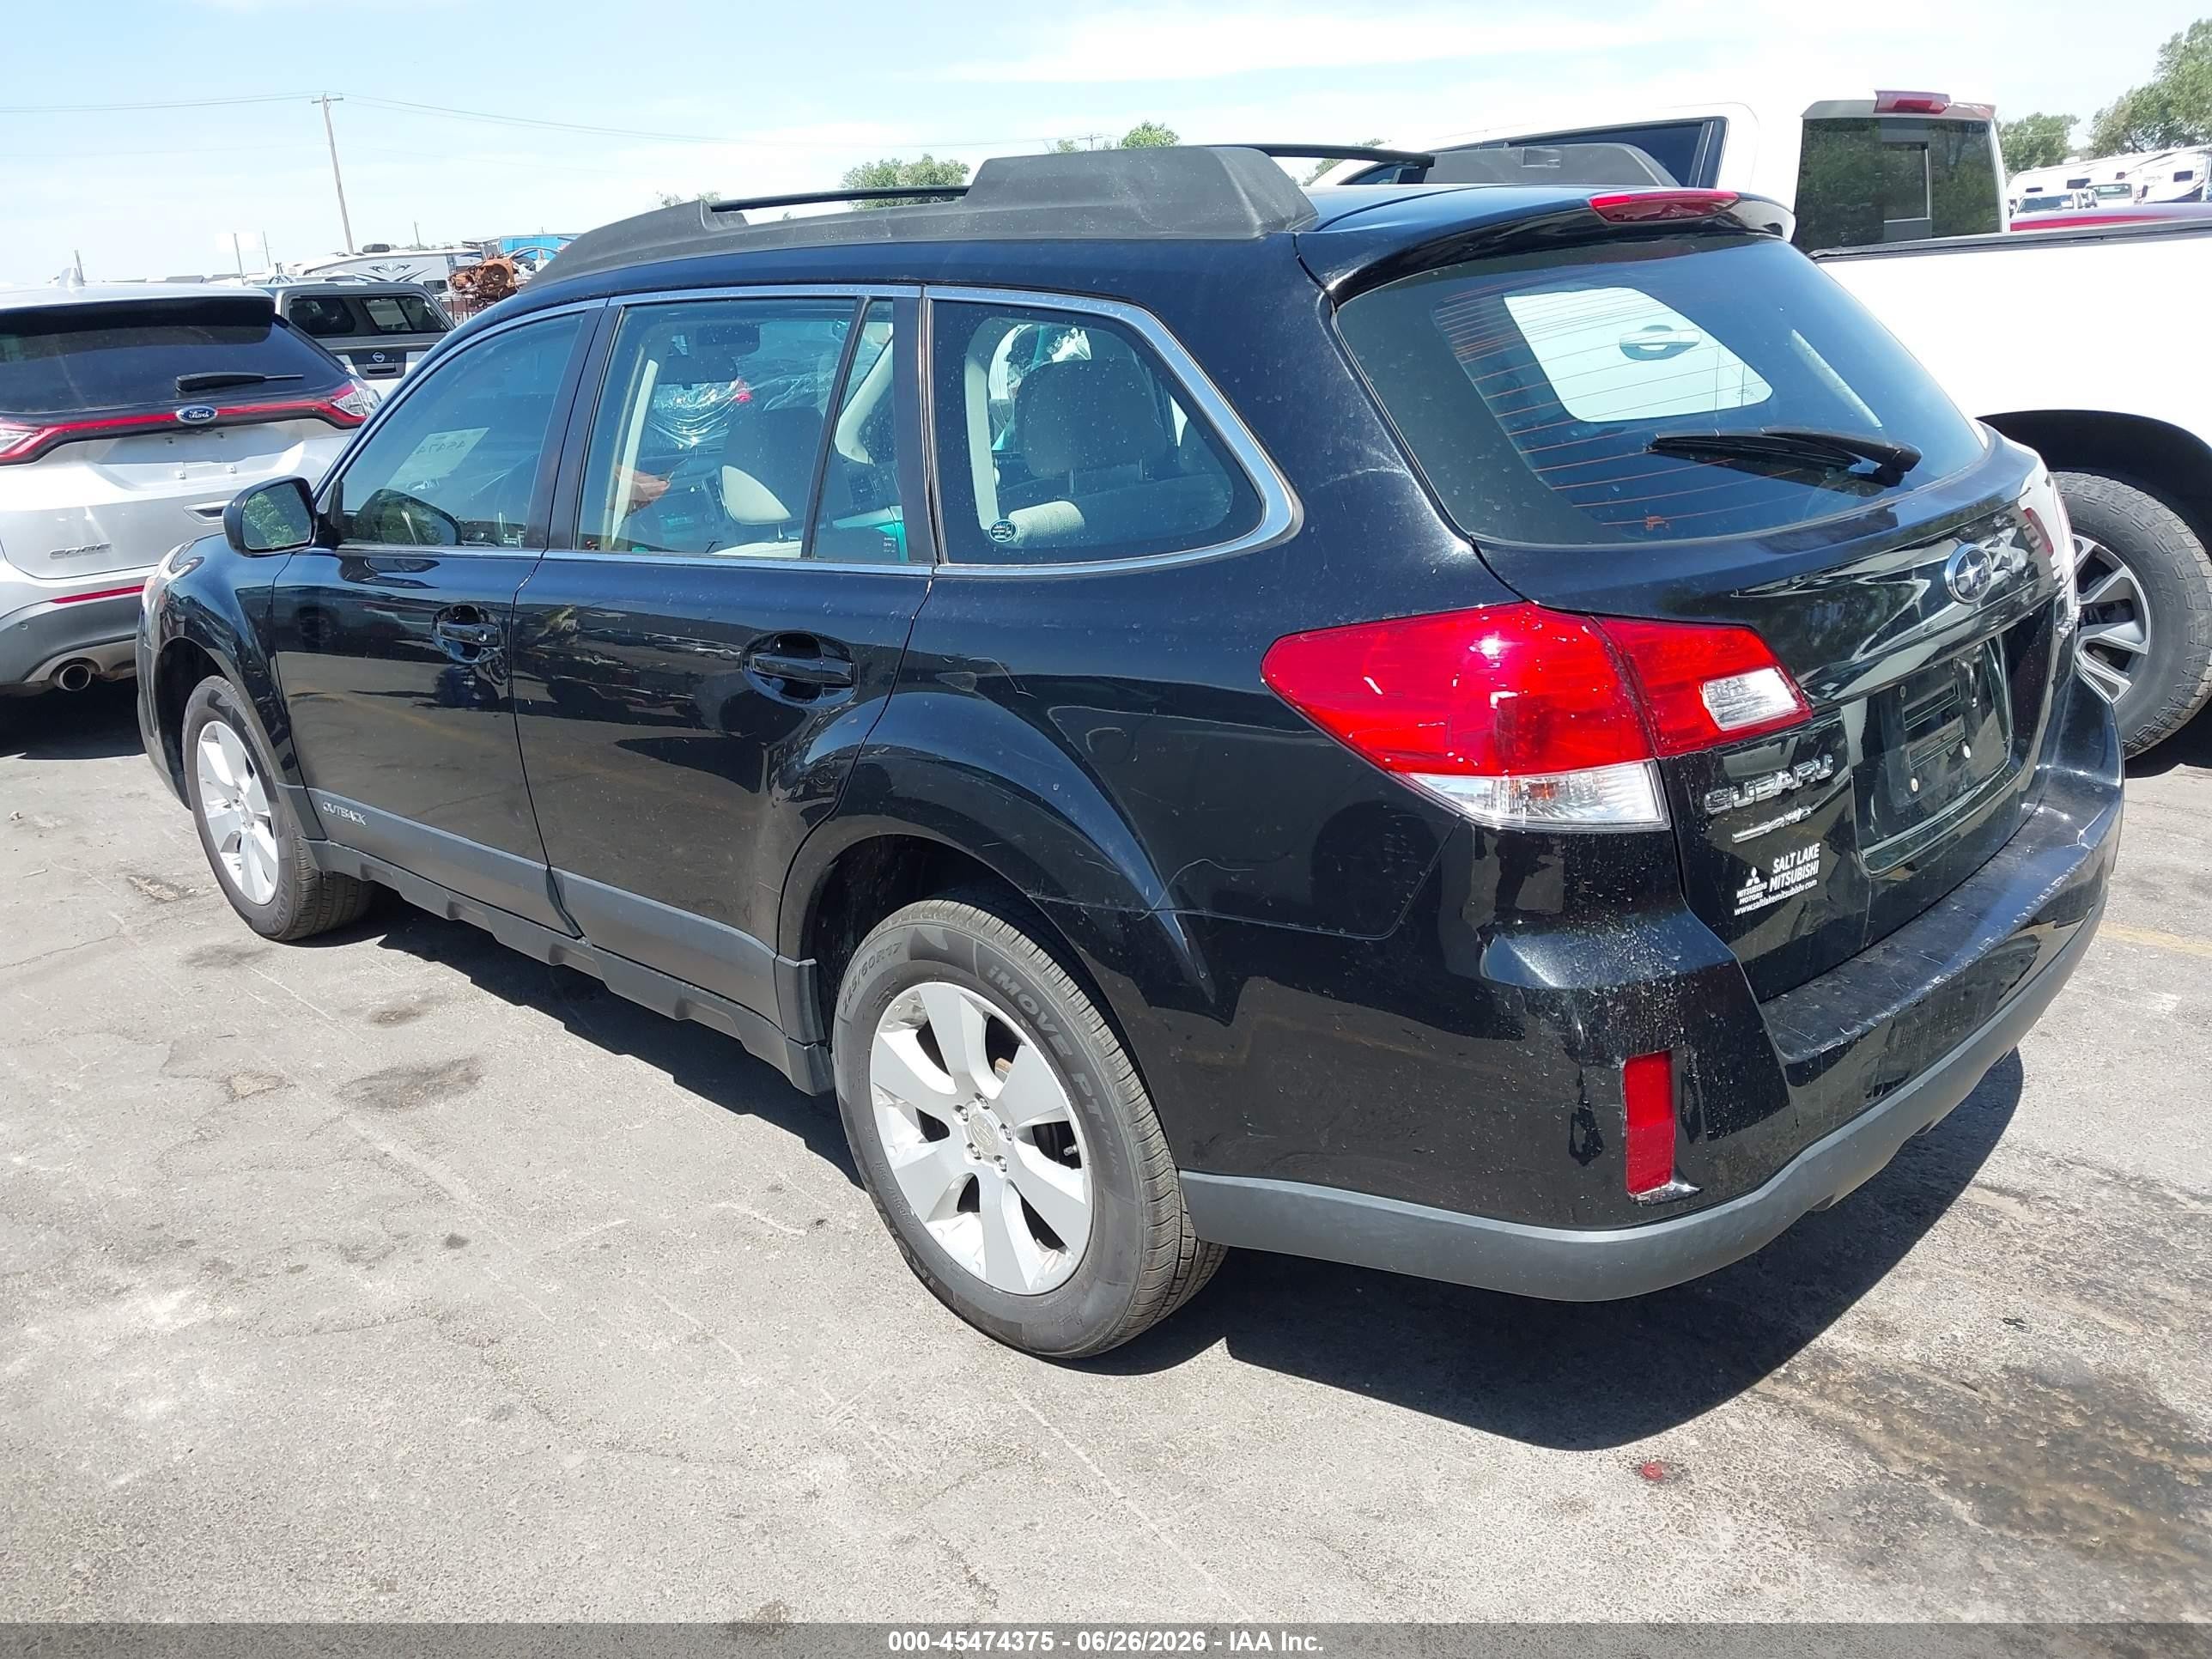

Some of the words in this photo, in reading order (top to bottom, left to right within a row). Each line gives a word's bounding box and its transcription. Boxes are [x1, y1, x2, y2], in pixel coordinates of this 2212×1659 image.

[188, 410, 210, 419] Ford
[49, 542, 111, 561] EDGE
[1705, 754, 1833, 815] SUBARU
[323, 800, 368, 825] OUTBACK
[1772, 852, 1796, 874] SALT
[1796, 842, 1820, 865] LAKE
[1736, 881, 1768, 899] MITSUBISHI
[1769, 860, 1820, 892] MITSUBISHI
[1734, 879, 1818, 916] www.saltlakemitsubishi.com
[1739, 891, 1764, 905] MOTORS
[987, 964, 1073, 1058] iMOVE
[1073, 1073, 1107, 1122] PT
